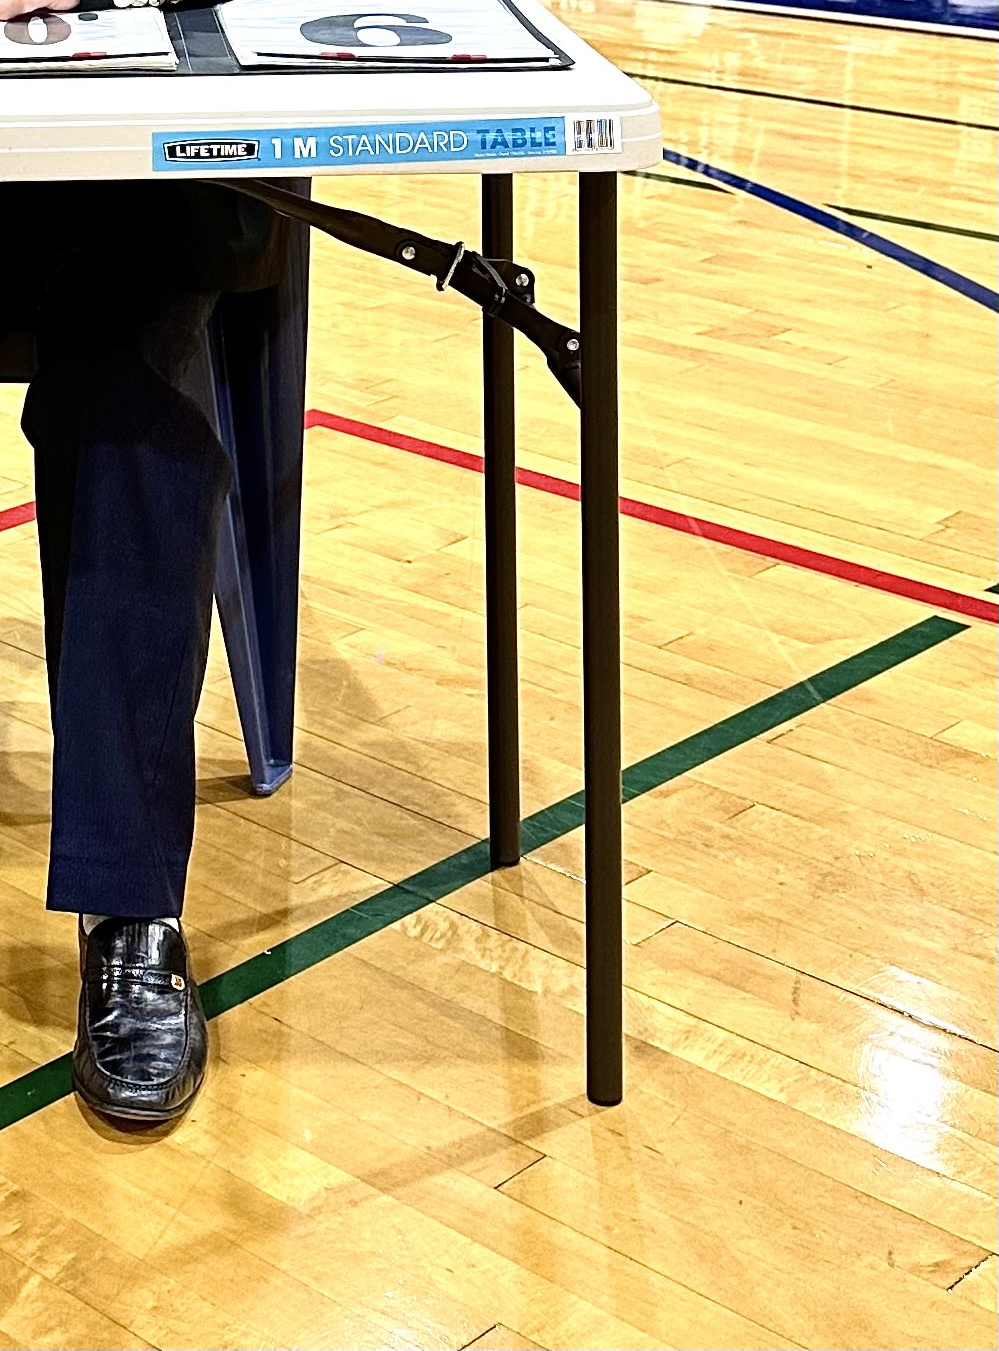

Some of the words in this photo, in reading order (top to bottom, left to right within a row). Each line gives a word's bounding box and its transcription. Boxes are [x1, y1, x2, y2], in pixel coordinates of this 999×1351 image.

[176, 143, 247, 158] LIFETIME
[271, 138, 282, 158] 1
[294, 137, 317, 158] M
[329, 129, 468, 156] STANDARD
[476, 125, 557, 150] TABLE
